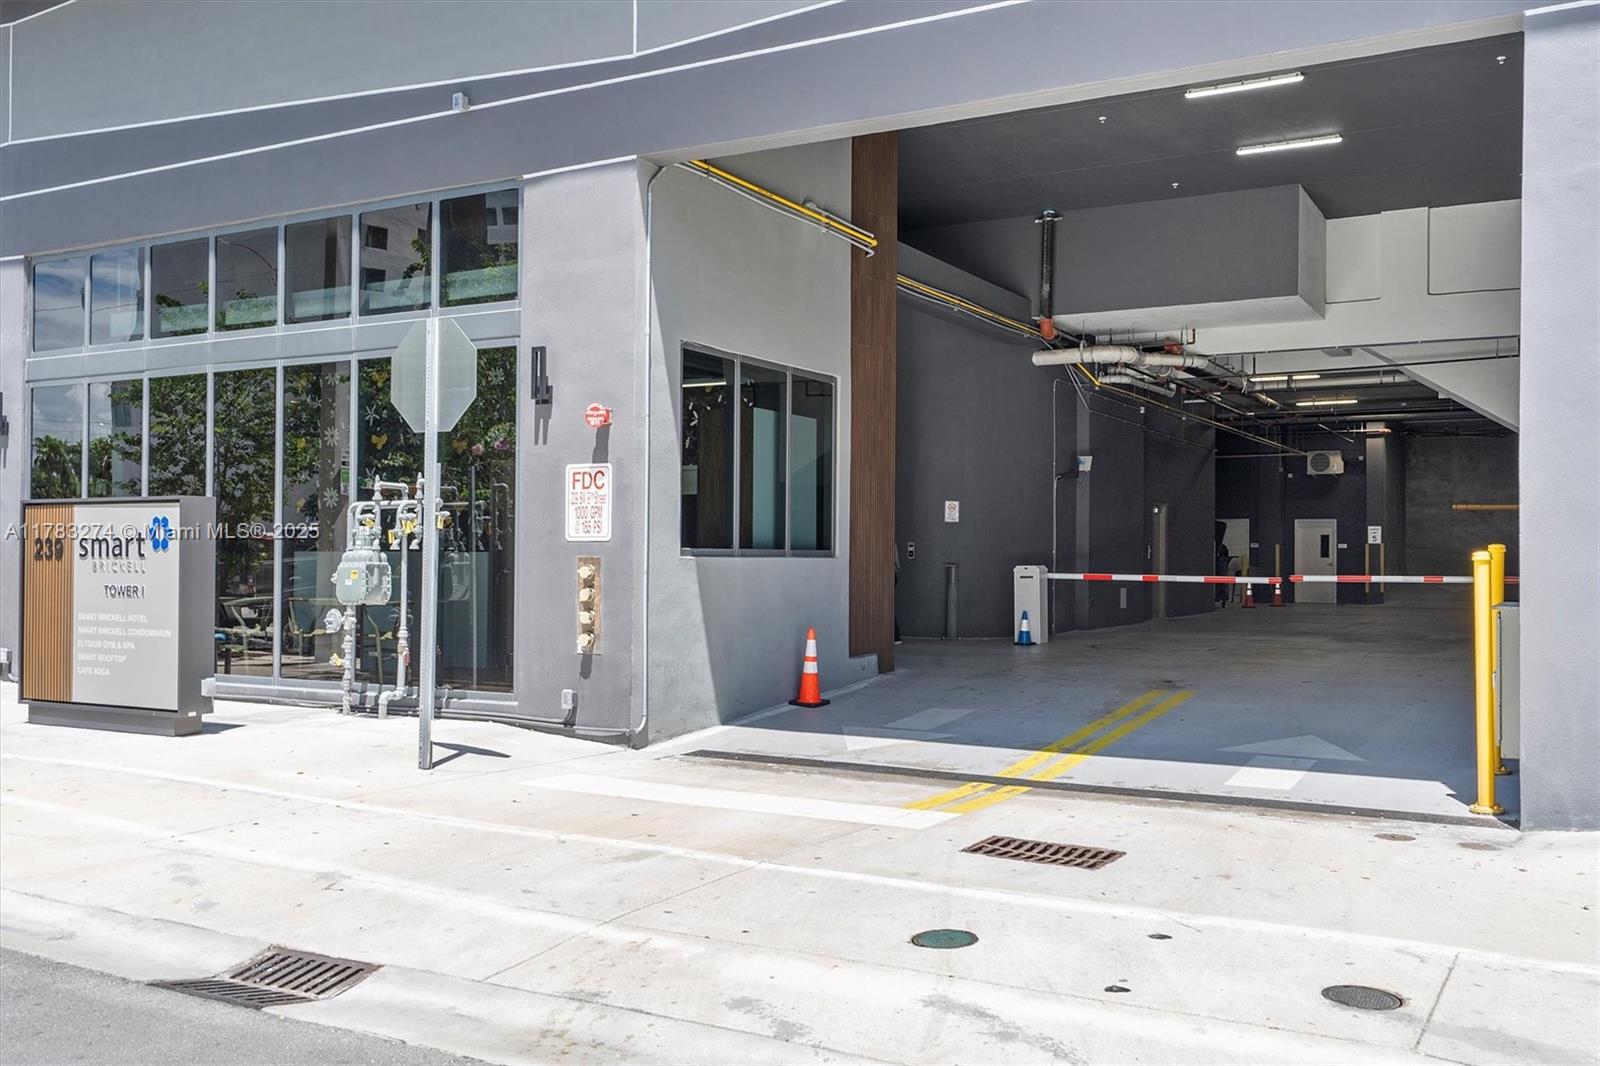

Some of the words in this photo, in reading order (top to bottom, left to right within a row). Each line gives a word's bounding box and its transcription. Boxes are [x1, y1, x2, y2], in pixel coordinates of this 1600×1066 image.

[572, 470, 605, 490] FDC
[79, 532, 146, 558] smart
[92, 561, 146, 574] BRICKELL
[104, 585, 140, 599] TOWER
[78, 612, 97, 621] SMART
[98, 613, 127, 622] BRICKELL
[128, 614, 148, 623] HOTEL
[77, 626, 97, 634] SMART
[98, 627, 127, 636] BRICKELL
[128, 628, 172, 638] CONDOMINIUM
[123, 641, 136, 649] SPA
[77, 653, 97, 661] SMART
[98, 653, 127, 663] ROOFTOP
